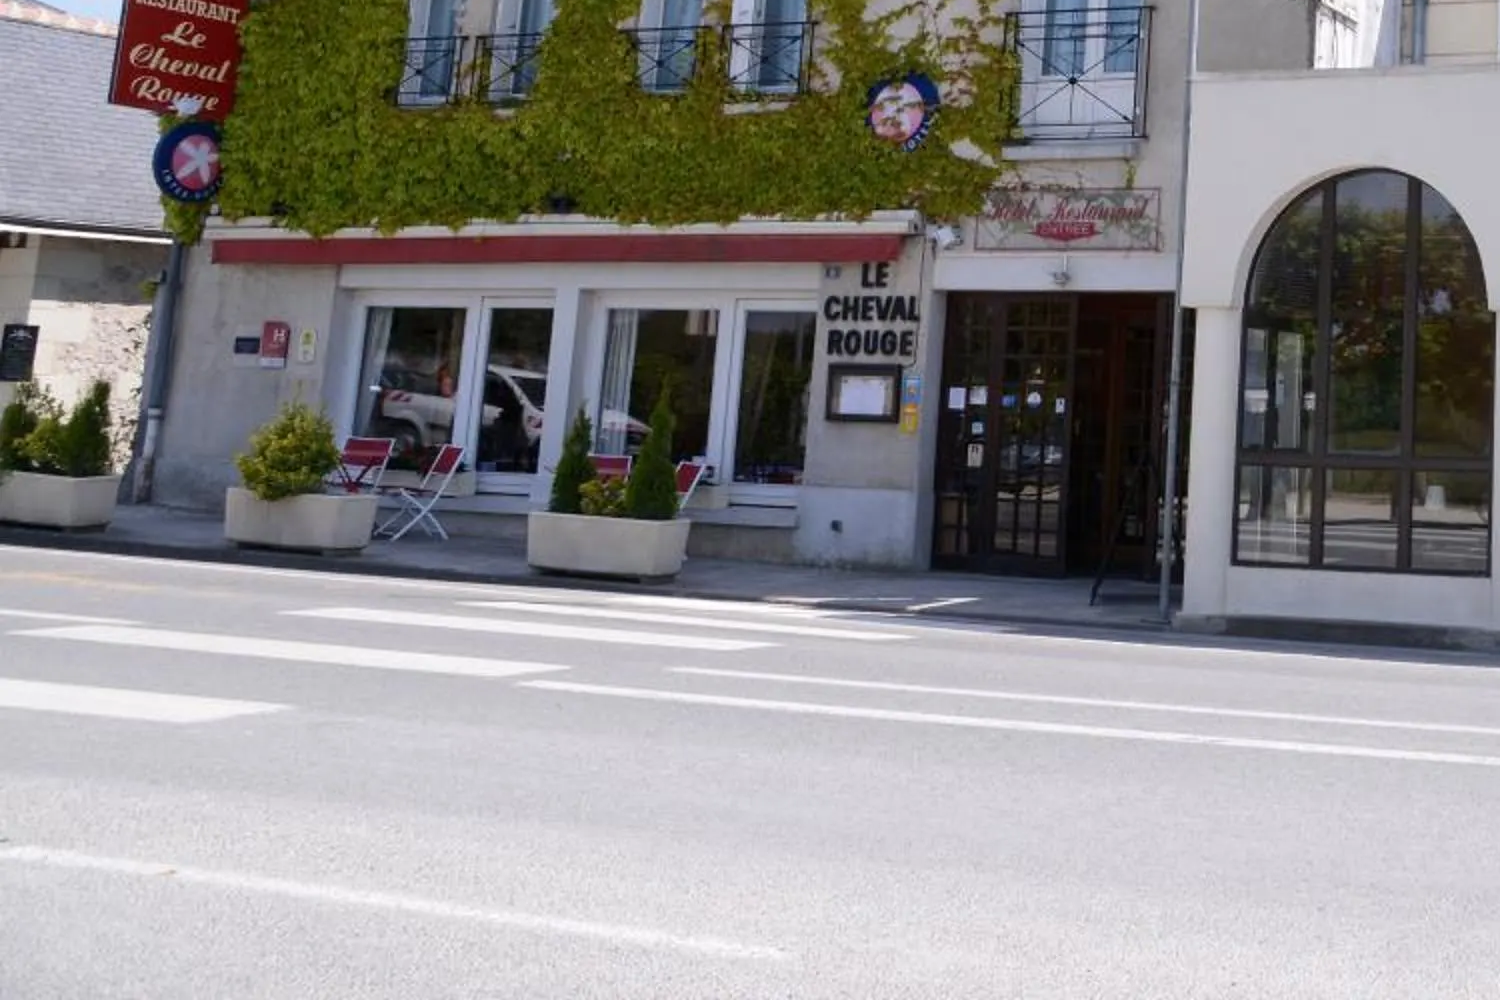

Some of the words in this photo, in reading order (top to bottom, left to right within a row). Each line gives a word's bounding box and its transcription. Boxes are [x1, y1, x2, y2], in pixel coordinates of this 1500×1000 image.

[160, 21, 206, 49] Le
[128, 43, 231, 84] Cheval
[861, 262, 888, 288] LE
[824, 295, 920, 322] CHEVAL
[826, 329, 914, 356] ROUGE
